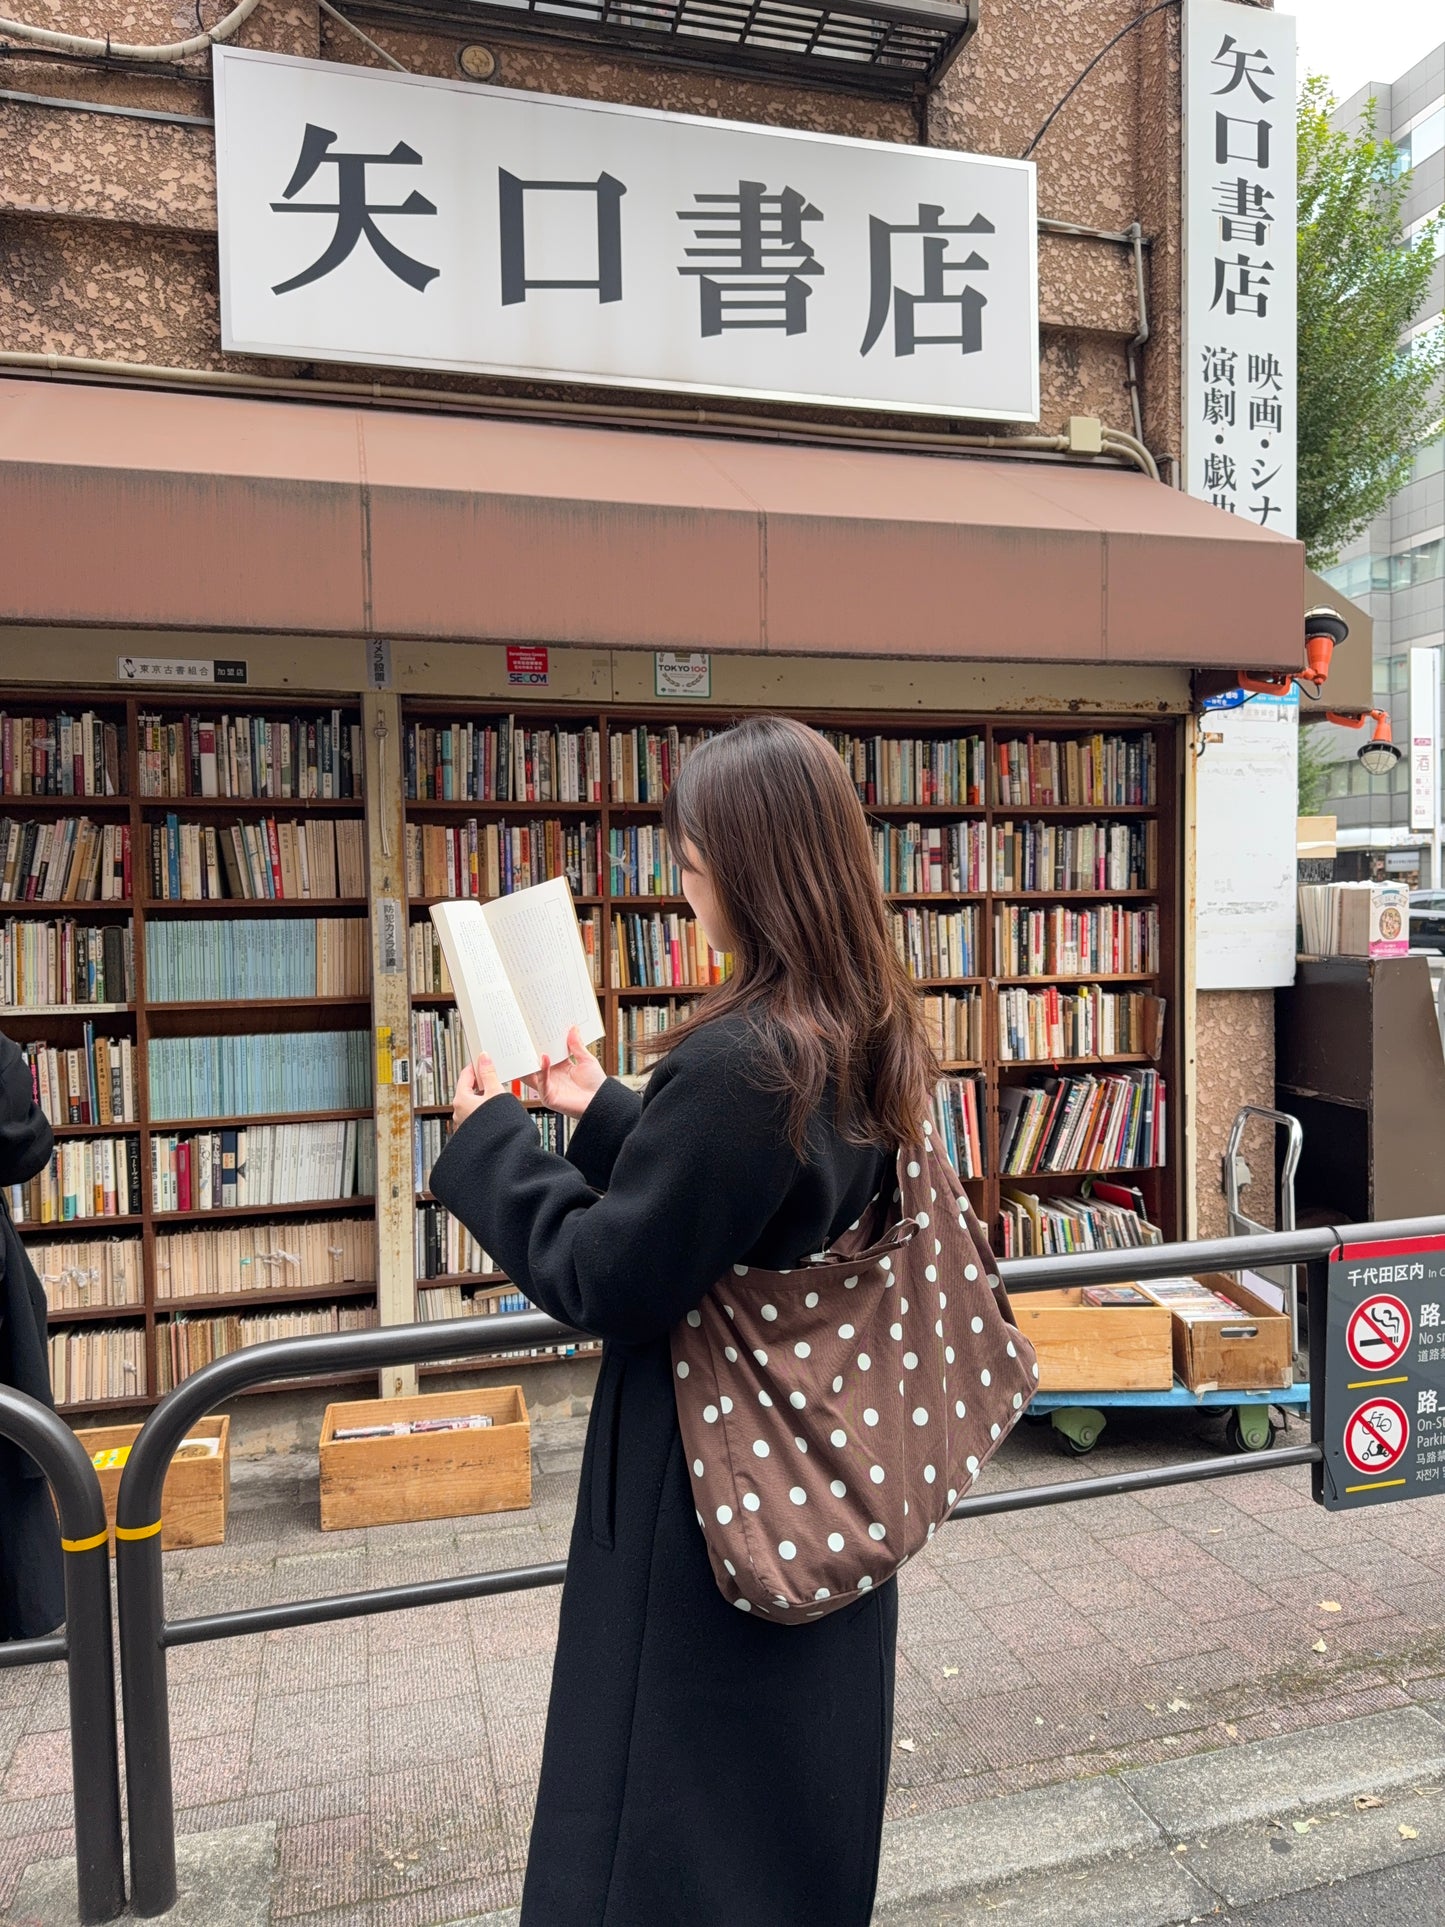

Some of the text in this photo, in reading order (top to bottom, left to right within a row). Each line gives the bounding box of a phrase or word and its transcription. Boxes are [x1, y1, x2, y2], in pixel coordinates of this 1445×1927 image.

[1209, 33, 1275, 319] 矢口書店
[269, 122, 995, 358] 矢口書店
[1247, 351, 1283, 526] 映画・シナ
[139, 664, 209, 677] 東京古書組合
[509, 673, 547, 684] SECOM
[1347, 1262, 1424, 1287] 千代田区内
[1428, 1269, 1437, 1278] In
[1419, 1332, 1434, 1345] No
[1416, 1467, 1440, 1481] 자전거
